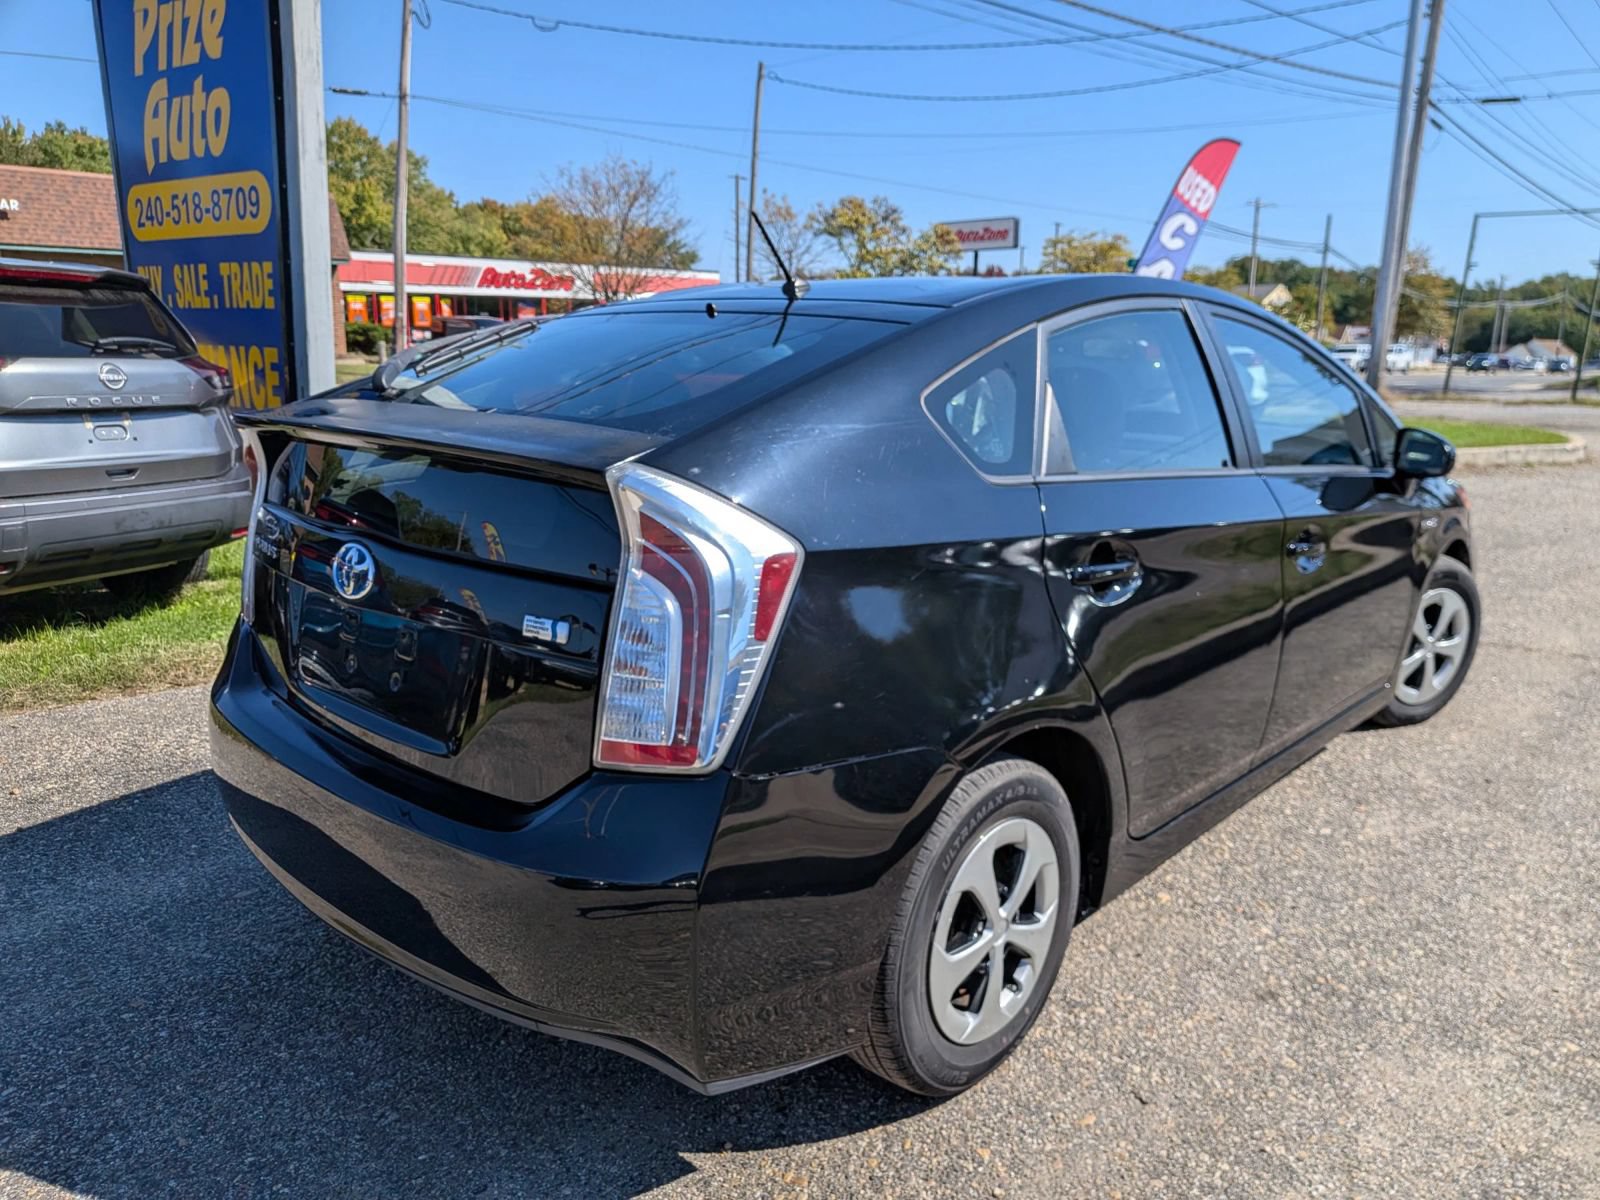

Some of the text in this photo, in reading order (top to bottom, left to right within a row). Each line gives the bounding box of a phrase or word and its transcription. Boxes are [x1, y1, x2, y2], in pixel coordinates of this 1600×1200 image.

[134, 0, 226, 77] Prize
[143, 74, 231, 176] Auto
[134, 184, 261, 229] 240-518-8709
[173, 262, 211, 310] SALE
[219, 260, 276, 310] TRADE
[941, 792, 1006, 873] ULTRAMAX
